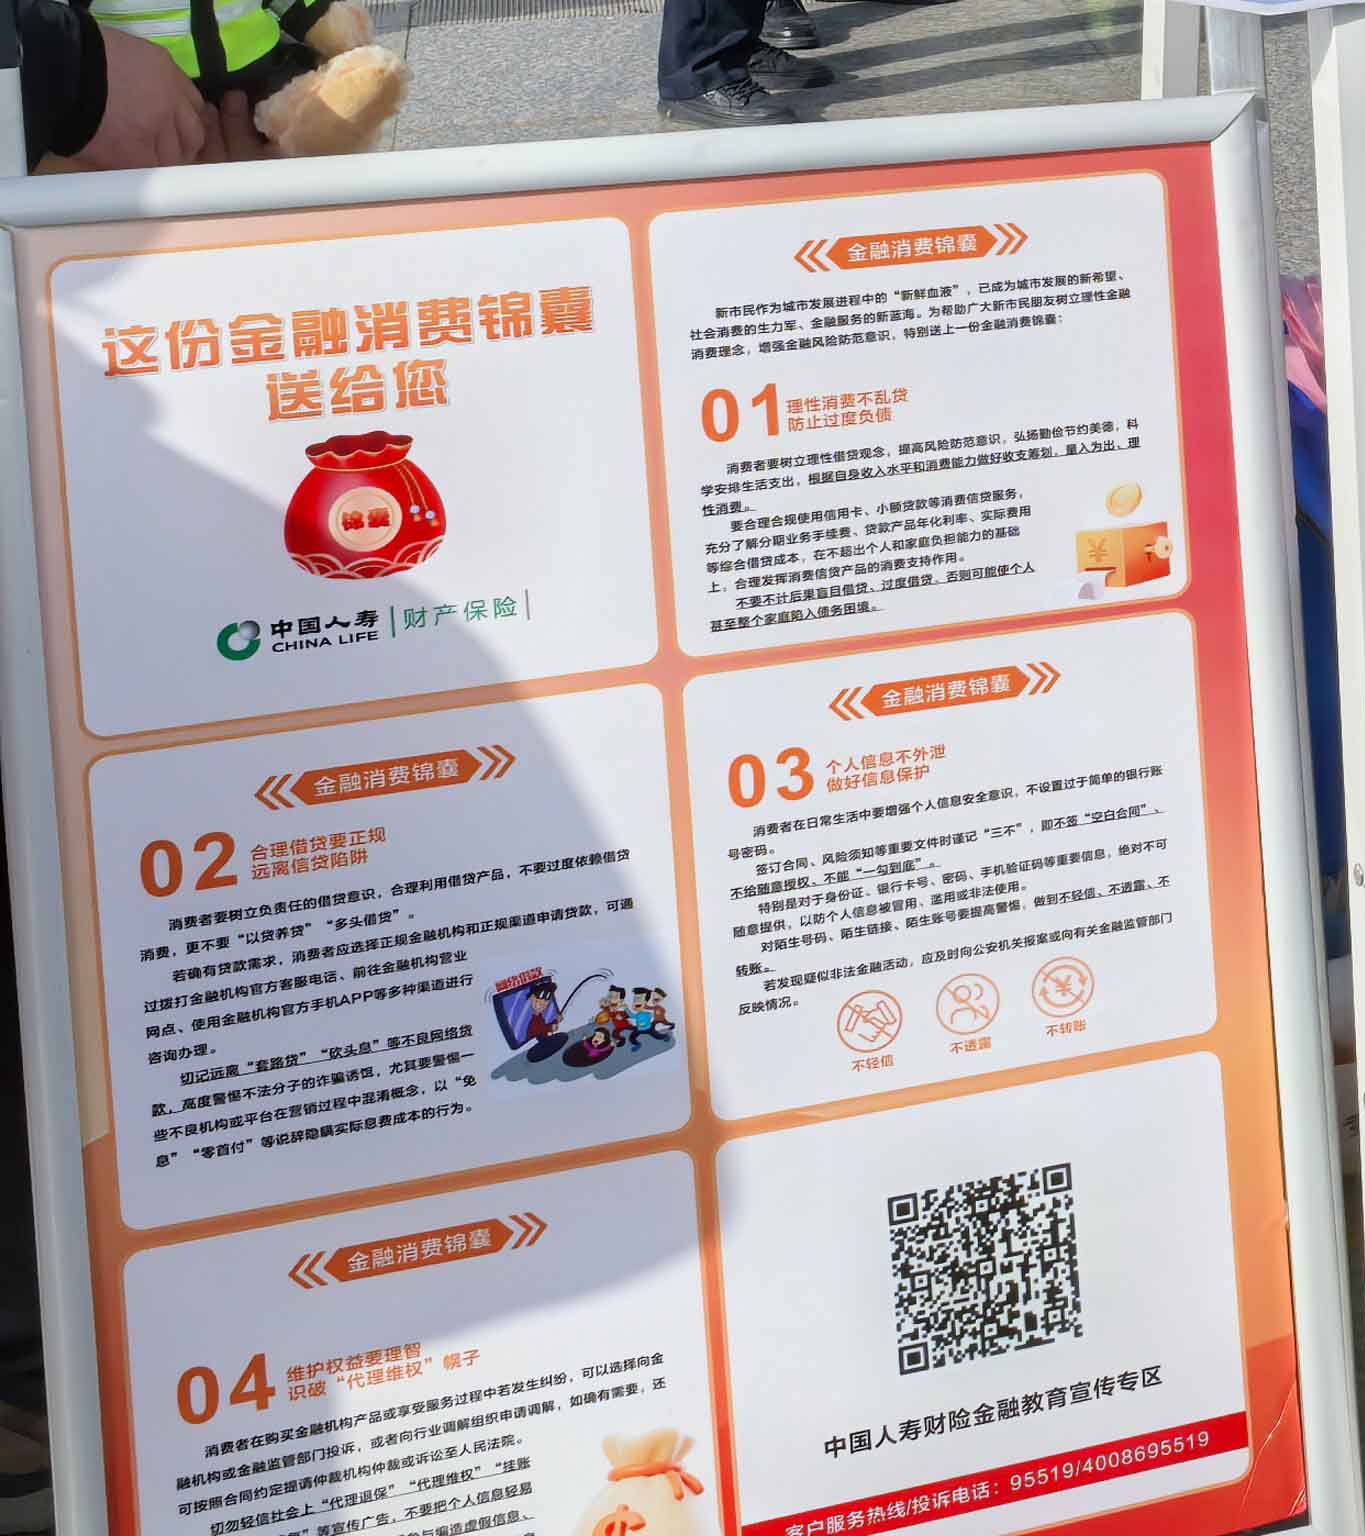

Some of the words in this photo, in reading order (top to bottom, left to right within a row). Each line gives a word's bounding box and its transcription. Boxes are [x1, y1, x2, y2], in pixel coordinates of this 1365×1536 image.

[847, 232, 978, 264] 金融消费锦囊
[102, 285, 594, 378] 这份金融消费锦囊
[266, 358, 450, 422] 送给您
[785, 387, 909, 415] 理性消费不乱贷
[700, 383, 780, 443] 01
[787, 407, 893, 433] 防止过度负债
[702, 500, 754, 518] 性消费。
[270, 609, 380, 639] 中国人寿
[402, 595, 518, 631] 财产保险
[271, 634, 332, 654] CHINA
[338, 630, 379, 646] LIFE
[881, 673, 1011, 709] 金融消费锦囊
[826, 743, 946, 774] 个人信息不外泄
[313, 758, 460, 797] 金融消费锦囊
[728, 747, 815, 809] 03
[826, 765, 931, 793] 做好信息保护
[250, 827, 387, 861] 合理借贷要正规
[727, 841, 776, 861] 号密码。
[139, 831, 238, 897] 02
[251, 849, 370, 880] 远离信贷陷阱
[738, 996, 800, 1017] 反映情况。
[1045, 1019, 1087, 1036] 不转账
[147, 1042, 218, 1065] 咨询办理。
[949, 1037, 992, 1054] 不透露
[851, 1055, 895, 1072] 不轻信
[347, 1229, 492, 1274] 金融消费锦囊
[286, 1341, 422, 1383] 维护权益要理智
[176, 1353, 276, 1425] 04
[823, 1365, 1162, 1459] 中国人寿财险金融教育宣传专区
